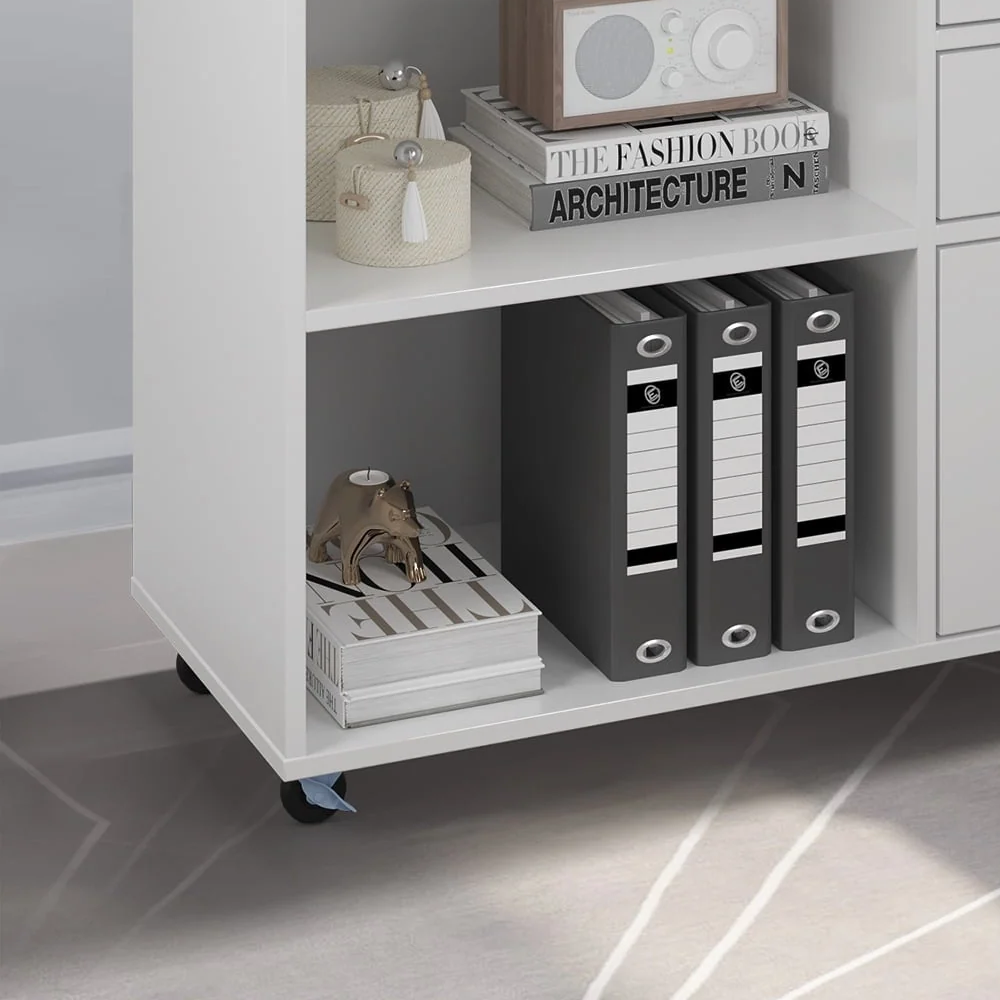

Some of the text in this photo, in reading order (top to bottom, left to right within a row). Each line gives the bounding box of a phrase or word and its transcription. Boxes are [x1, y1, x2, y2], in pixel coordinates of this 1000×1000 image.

[550, 119, 820, 179] THE FASHION BOOK
[548, 165, 749, 225] ARCHITECTURE
